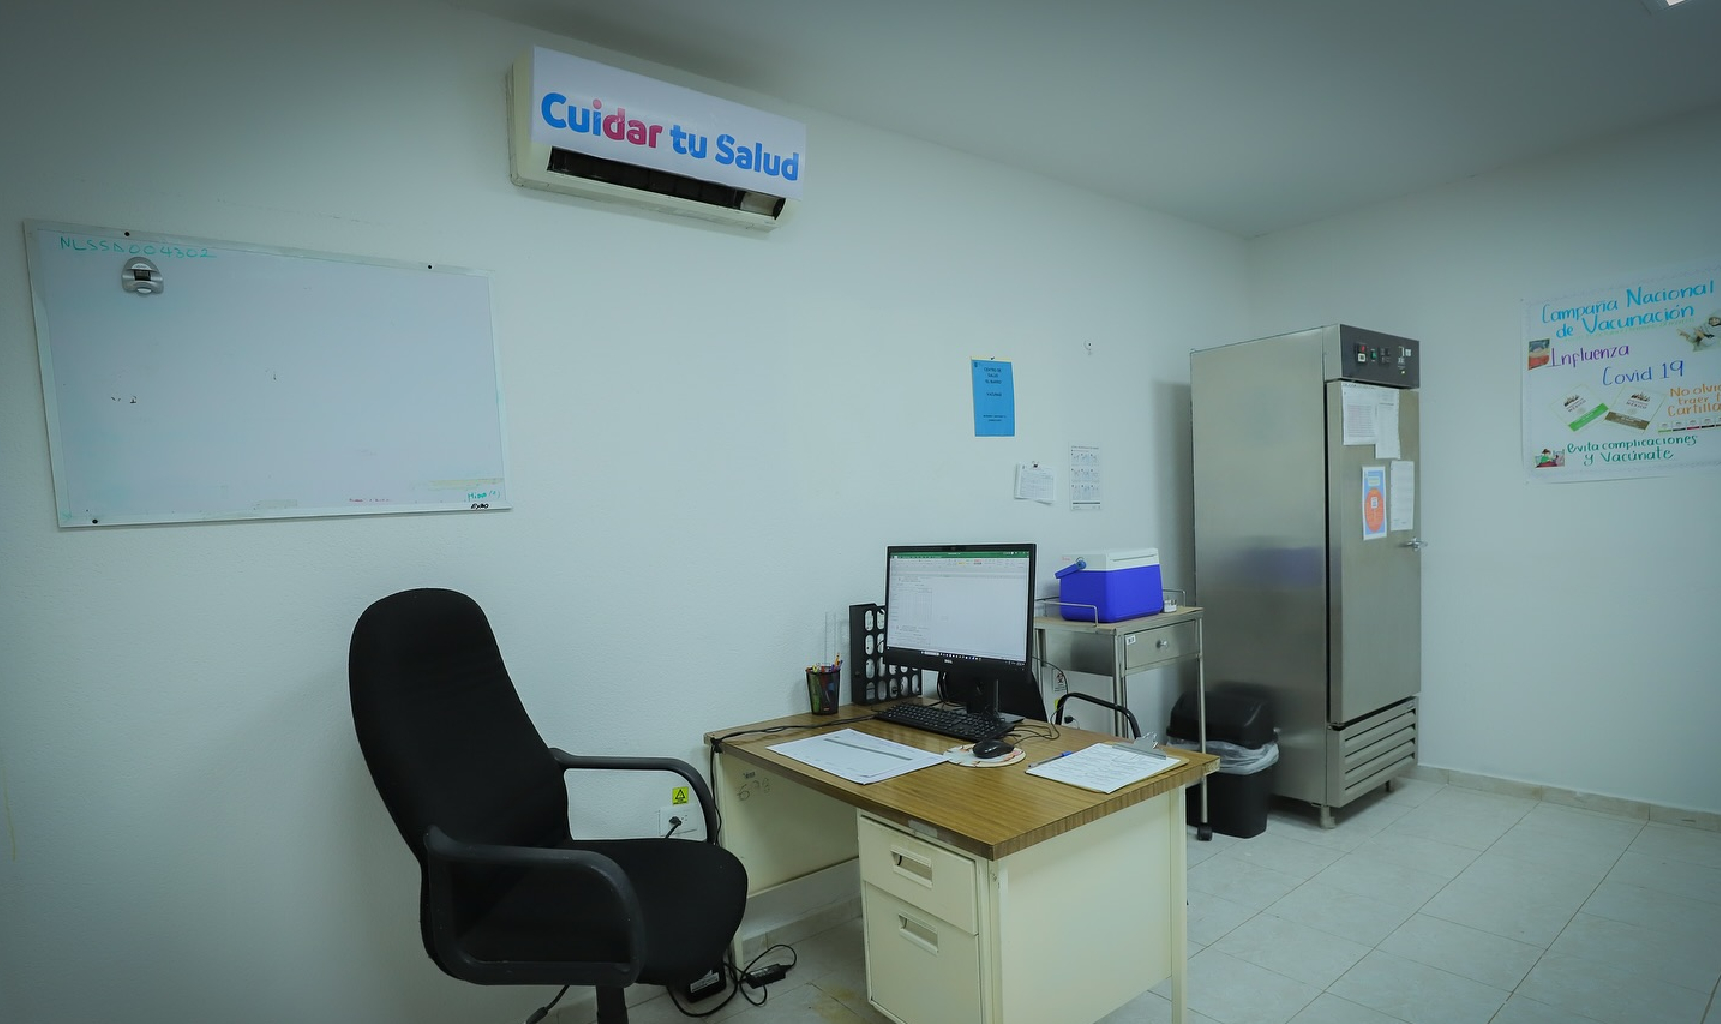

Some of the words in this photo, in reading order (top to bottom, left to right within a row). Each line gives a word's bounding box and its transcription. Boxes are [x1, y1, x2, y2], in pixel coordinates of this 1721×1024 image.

[540, 92, 663, 149] Cuidar
[670, 124, 708, 159] tu
[714, 134, 800, 181] Salud
[1626, 280, 1715, 307] Nacional
[1556, 324, 1574, 339] de
[1582, 305, 1694, 334] Vacunación
[1548, 345, 1630, 368] Influenza
[1602, 366, 1652, 386] Covid
[1659, 360, 1684, 379] 19
[1670, 387, 1690, 397] No
[1602, 435, 1698, 452] complicaciones
[1584, 454, 1594, 467] y
